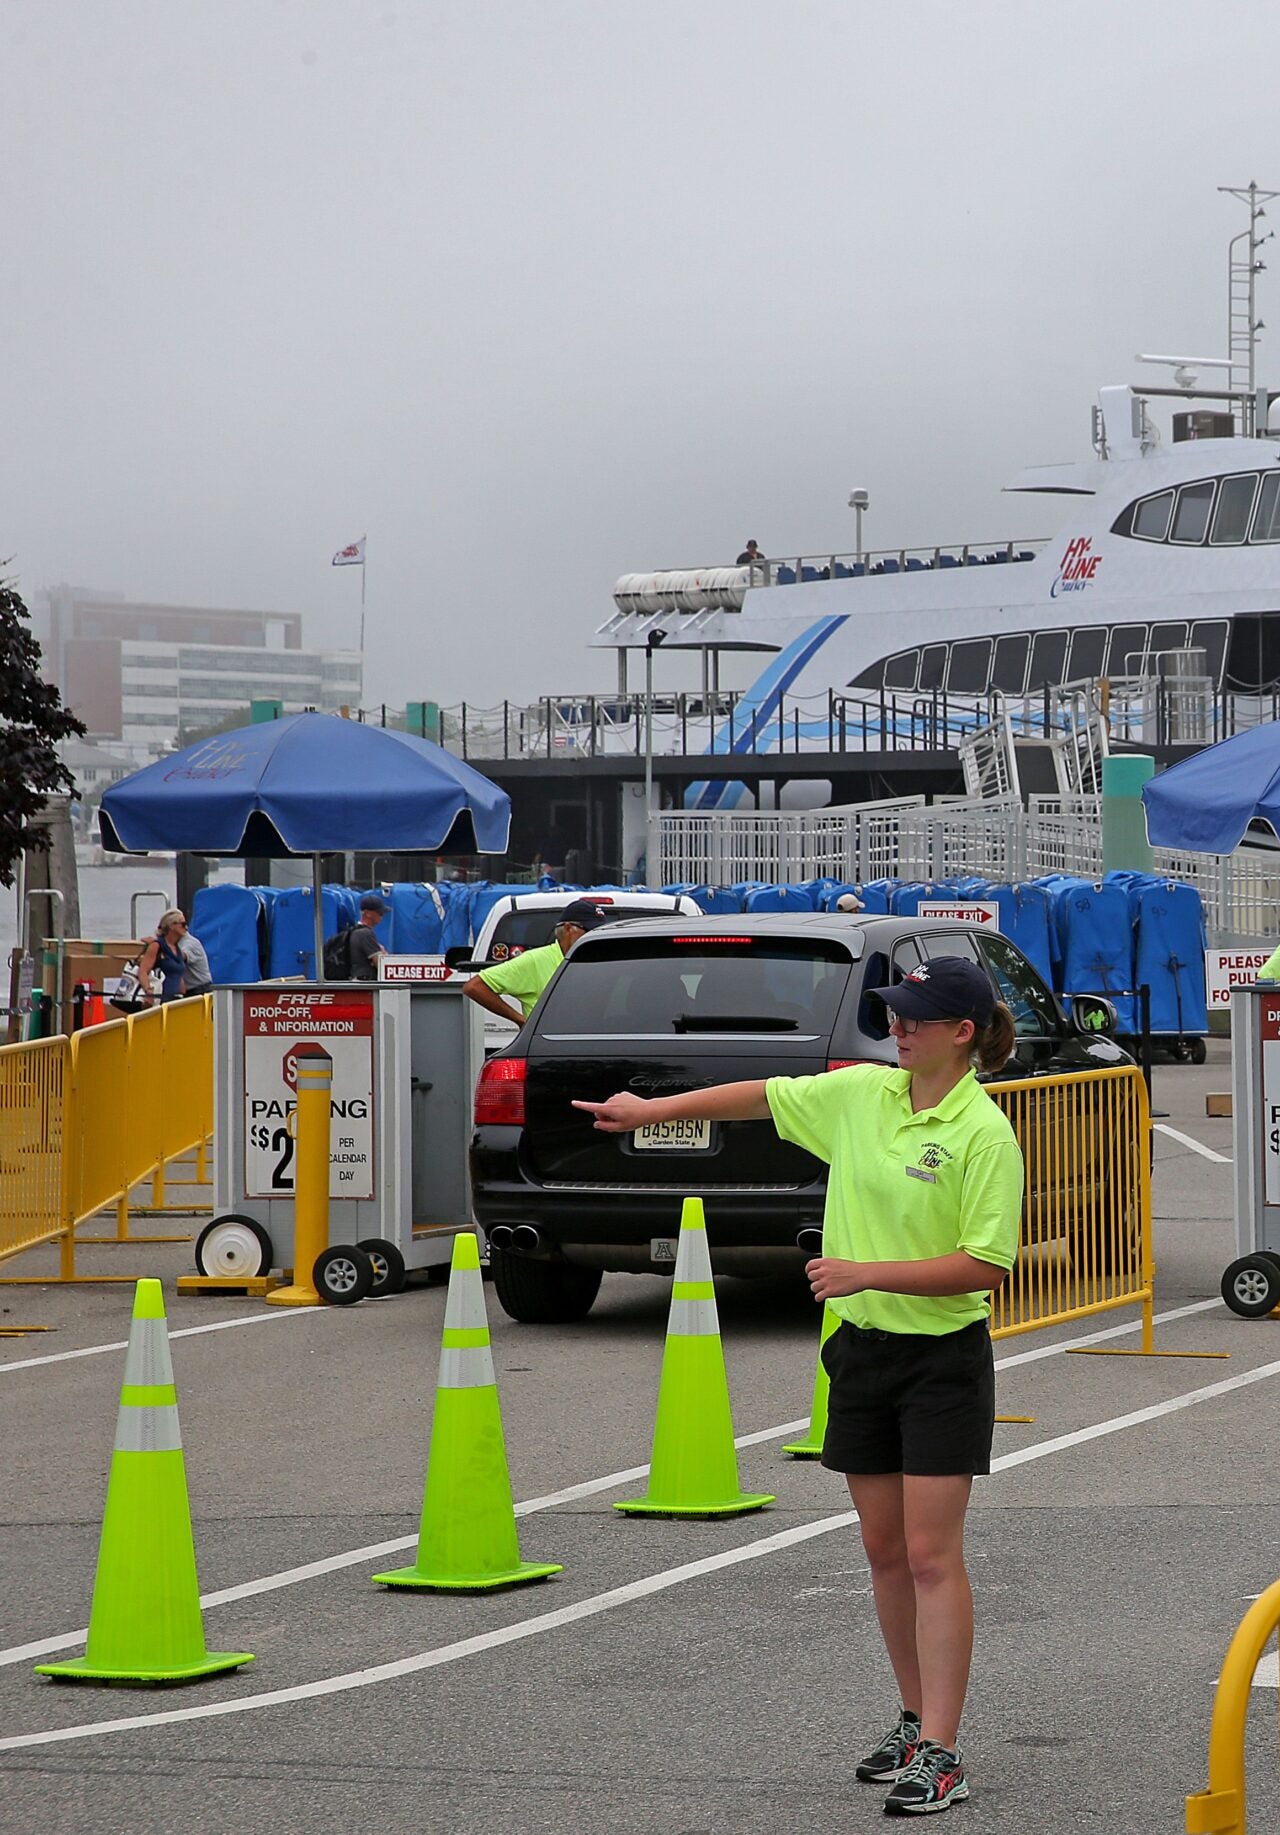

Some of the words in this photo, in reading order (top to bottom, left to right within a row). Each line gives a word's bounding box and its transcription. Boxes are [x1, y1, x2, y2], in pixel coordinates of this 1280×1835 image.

[1062, 556, 1102, 580] LINE
[963, 911, 984, 922] EXIT
[386, 967, 422, 979] PLEASE
[424, 966, 447, 979] EXIT
[277, 994, 335, 1004] FREE
[250, 1007, 312, 1019] DROP-OFF,
[259, 1022, 268, 1032] &
[274, 1022, 354, 1032] INFORMATION
[628, 1075, 697, 1091] Cayenne
[339, 1138, 354, 1148] PER
[329, 1154, 367, 1163] CALENDAR
[339, 1171, 355, 1181] DAY
